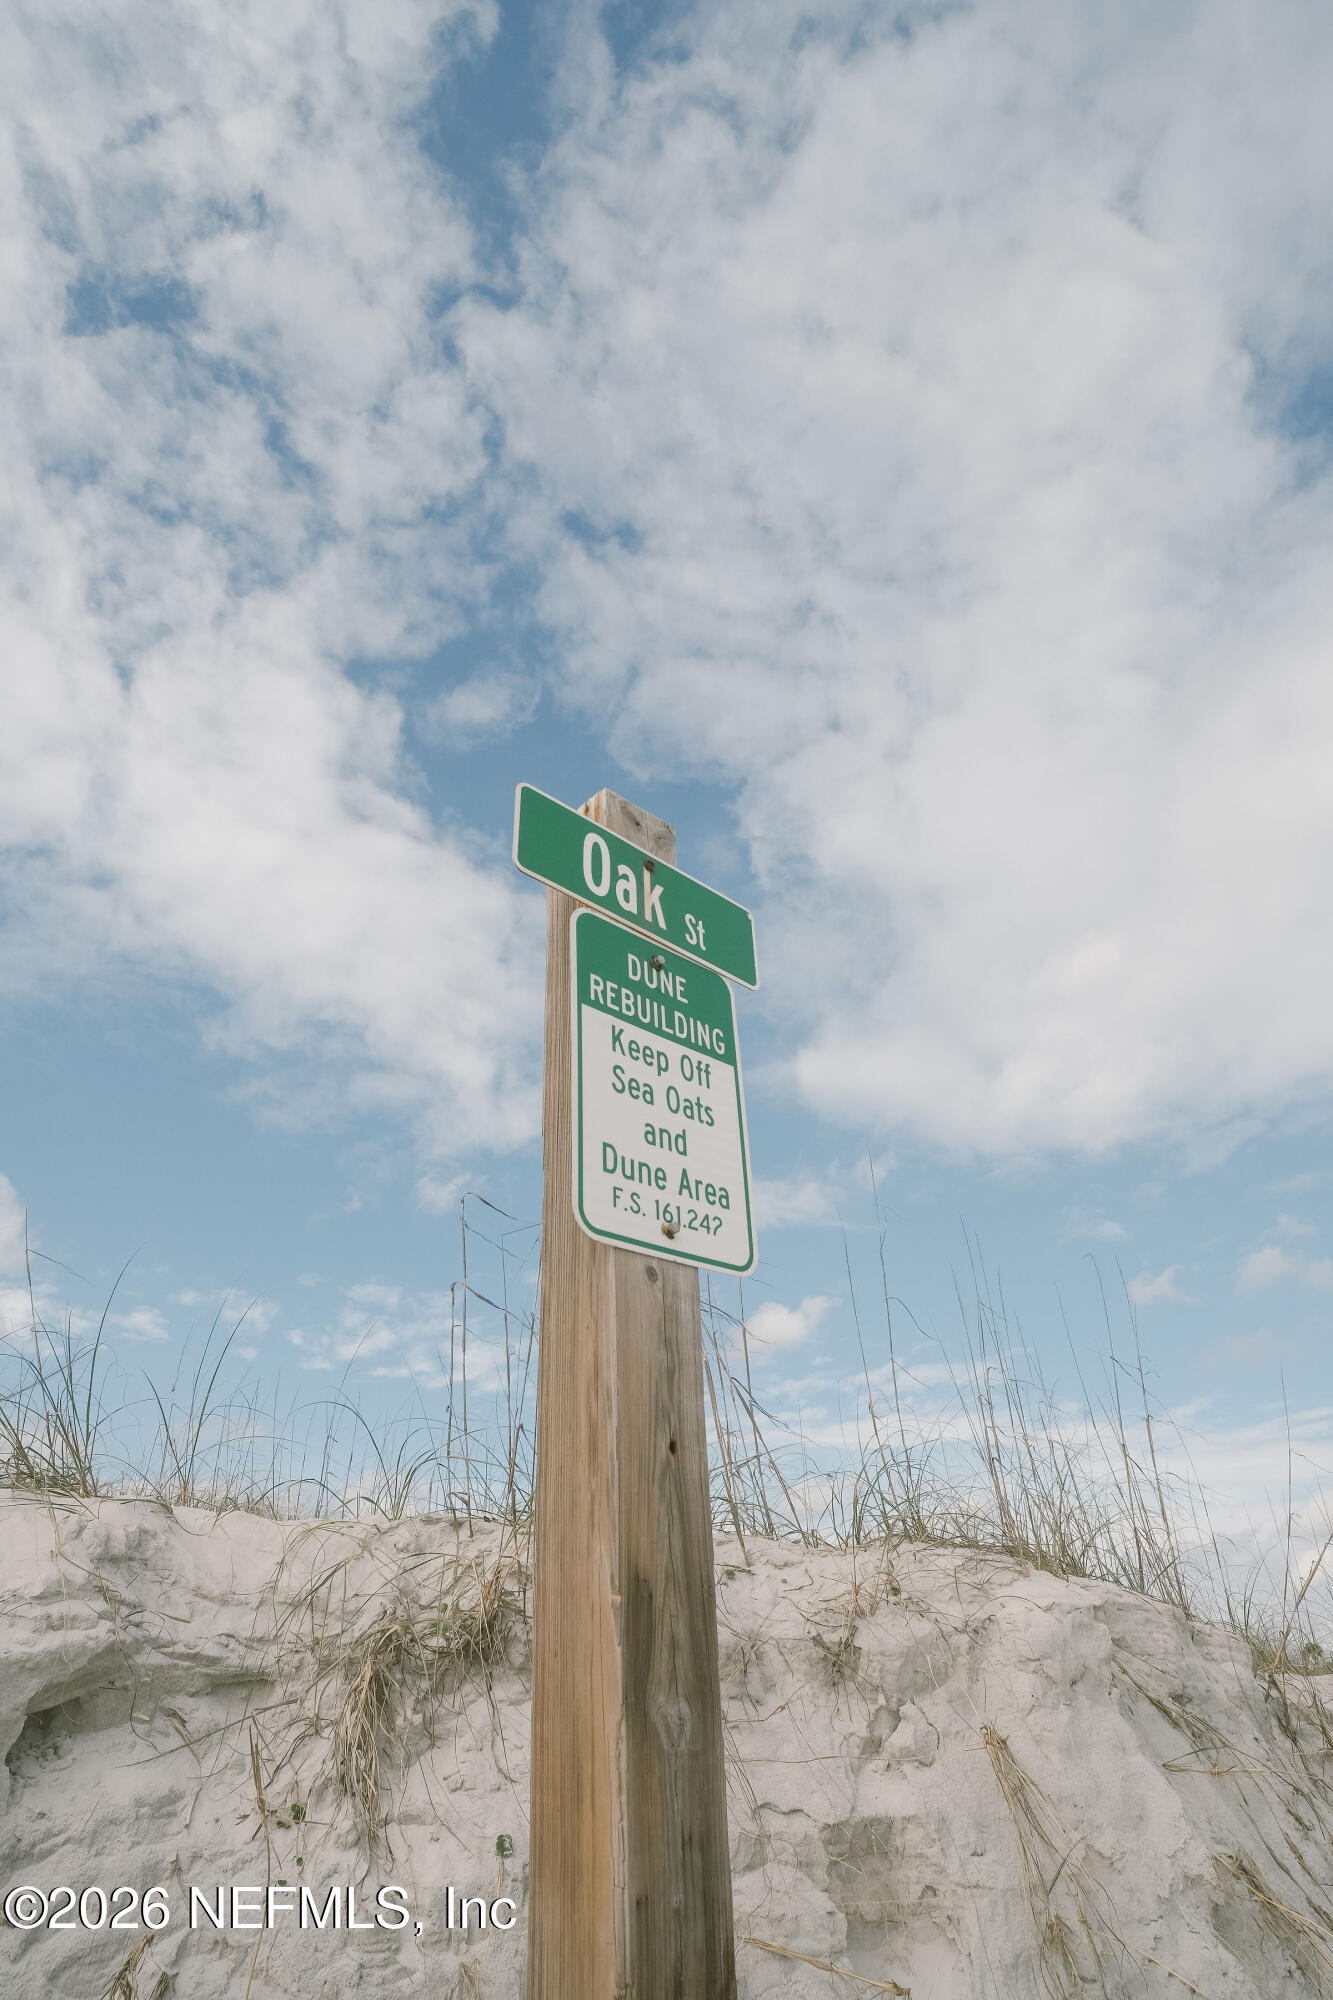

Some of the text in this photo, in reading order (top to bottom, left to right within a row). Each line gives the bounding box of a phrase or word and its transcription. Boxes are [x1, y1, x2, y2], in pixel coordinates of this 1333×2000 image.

[583, 832, 706, 951] Oak St
[628, 953, 688, 1004] DUNE
[590, 973, 725, 1055] REBUILDING
[611, 1025, 711, 1089] Keep Off
[611, 1064, 715, 1127] Sea Oats
[644, 1122, 687, 1156] and
[602, 1141, 730, 1210] Dune Area
[612, 1186, 646, 1217] F.S.
